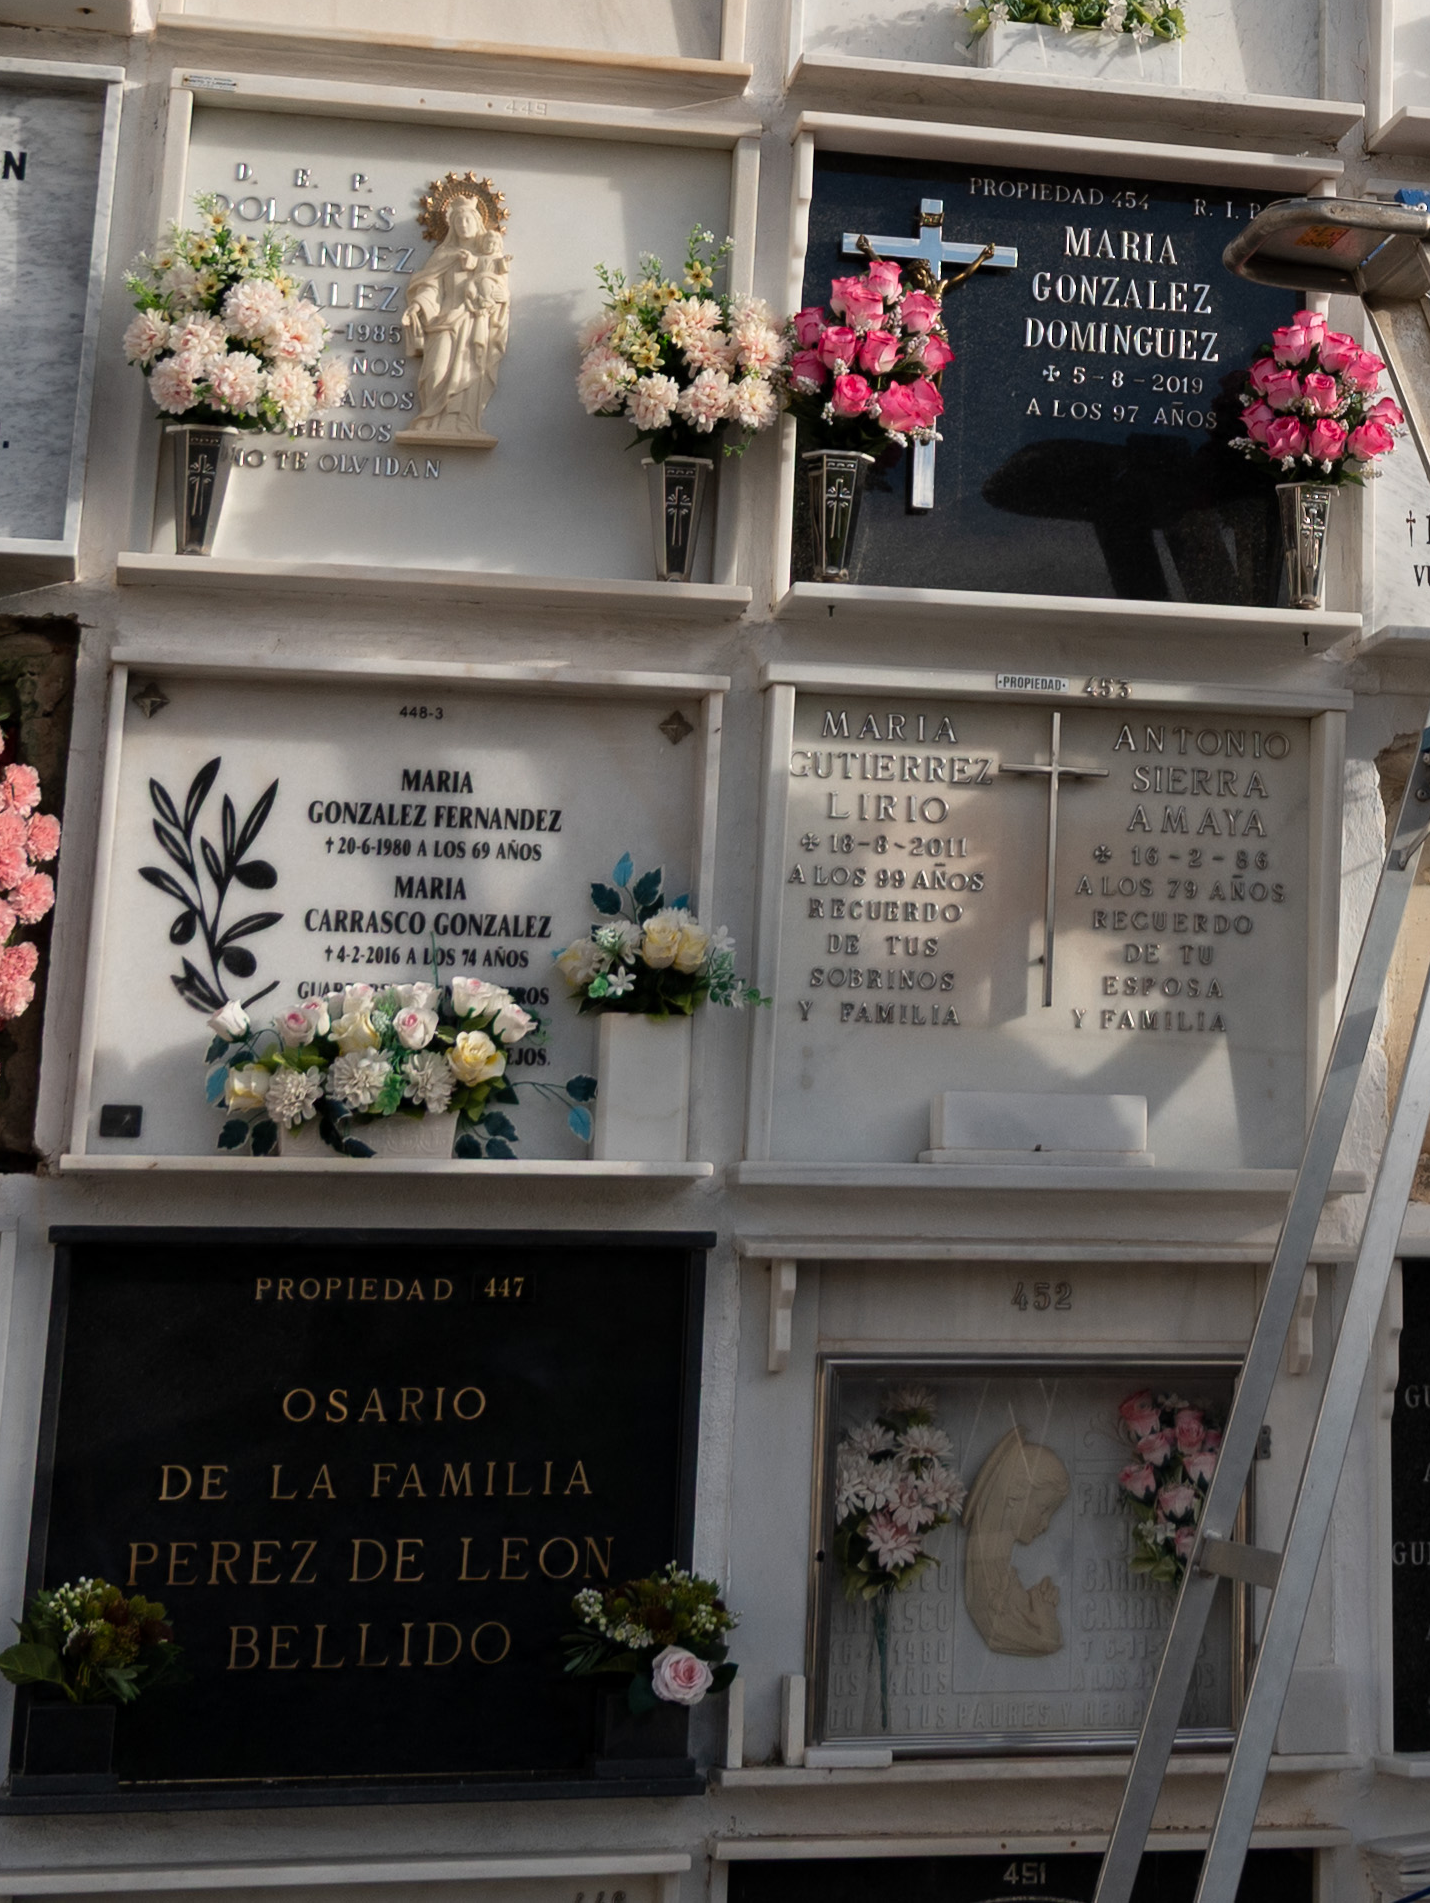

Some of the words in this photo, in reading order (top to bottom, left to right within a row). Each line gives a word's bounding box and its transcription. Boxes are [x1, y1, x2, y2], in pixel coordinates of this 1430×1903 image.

[969, 177, 1105, 207] PROPIEDAD
[1112, 191, 1149, 211] 454
[1063, 225, 1178, 266] MARIA
[1031, 272, 1213, 314] GONZALEZ
[1023, 317, 1220, 363] DOMINGUEZ
[1002, 675, 1062, 691] PROPIEDAD
[1084, 676, 1133, 699] 453
[399, 705, 445, 721] 448-3
[821, 710, 958, 743] MARIA
[1114, 724, 1291, 760] ANTONIO
[400, 769, 475, 794] MARIA
[789, 751, 993, 786] GUTIERREZ
[1132, 765, 1268, 798] SIERRA
[307, 800, 427, 829] GONZALEZ
[433, 804, 563, 833] FERNANDEZ
[827, 792, 950, 824] LIRIO
[1127, 804, 1268, 837] AMAYA
[337, 837, 411, 858] 20-6-1980
[416, 840, 428, 858] A
[433, 840, 466, 859] LOS
[472, 841, 491, 860] 69
[495, 839, 542, 862] AÑOS
[393, 876, 467, 901] MARIA
[304, 909, 425, 935] CARRASCO
[433, 913, 552, 939] GONZALEZ
[255, 1277, 454, 1301] PROPIEDAD
[484, 1276, 526, 1298] 447
[282, 1387, 486, 1423] OSARIO
[159, 1465, 229, 1501] DE
[270, 1463, 337, 1499] LA
[370, 1459, 593, 1497] FAMILIA
[125, 1540, 319, 1587] PEREZ
[349, 1539, 426, 1583] DE
[457, 1536, 615, 1581] LEON
[226, 1622, 511, 1672] BELLIDO
